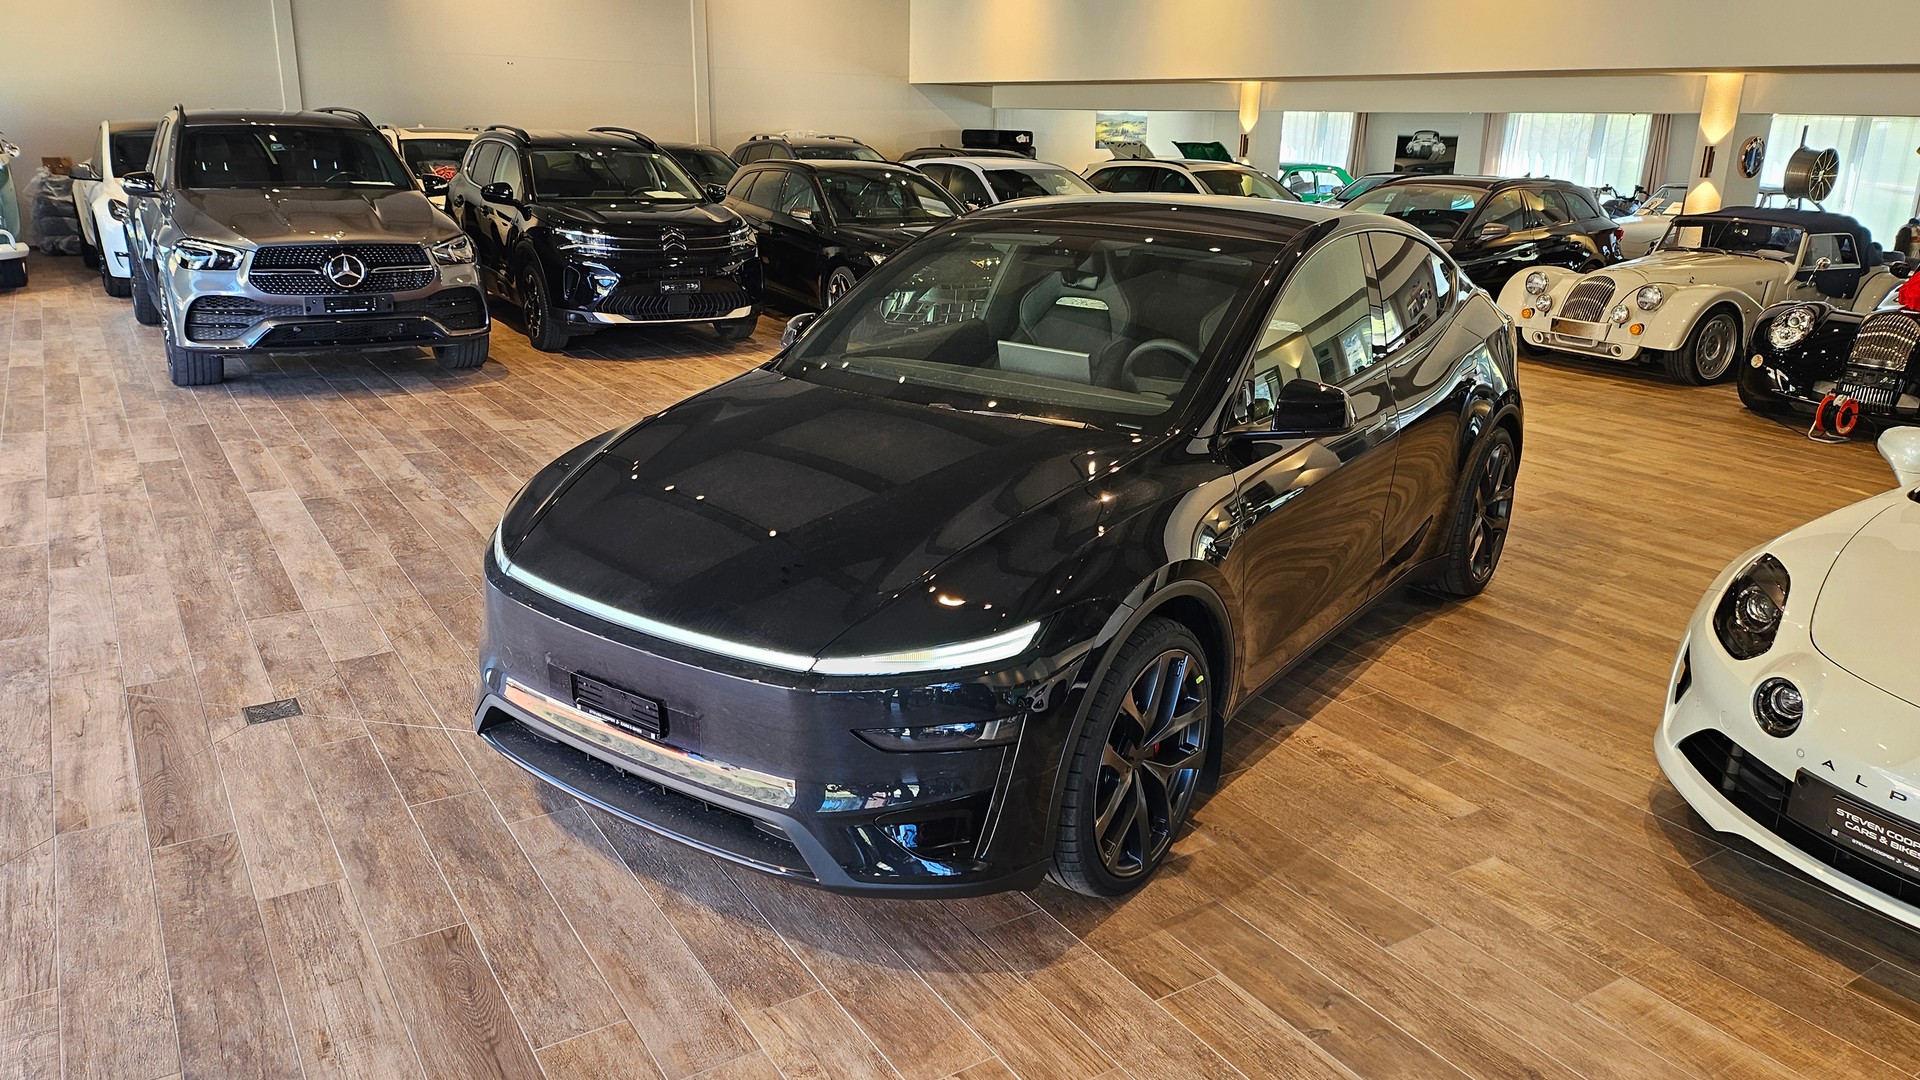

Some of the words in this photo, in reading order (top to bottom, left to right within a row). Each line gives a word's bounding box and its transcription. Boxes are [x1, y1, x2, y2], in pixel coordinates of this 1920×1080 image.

[1836, 807, 1885, 834] STEVEN
[1844, 820, 1877, 840] CARS
[1879, 835, 1888, 846] &
